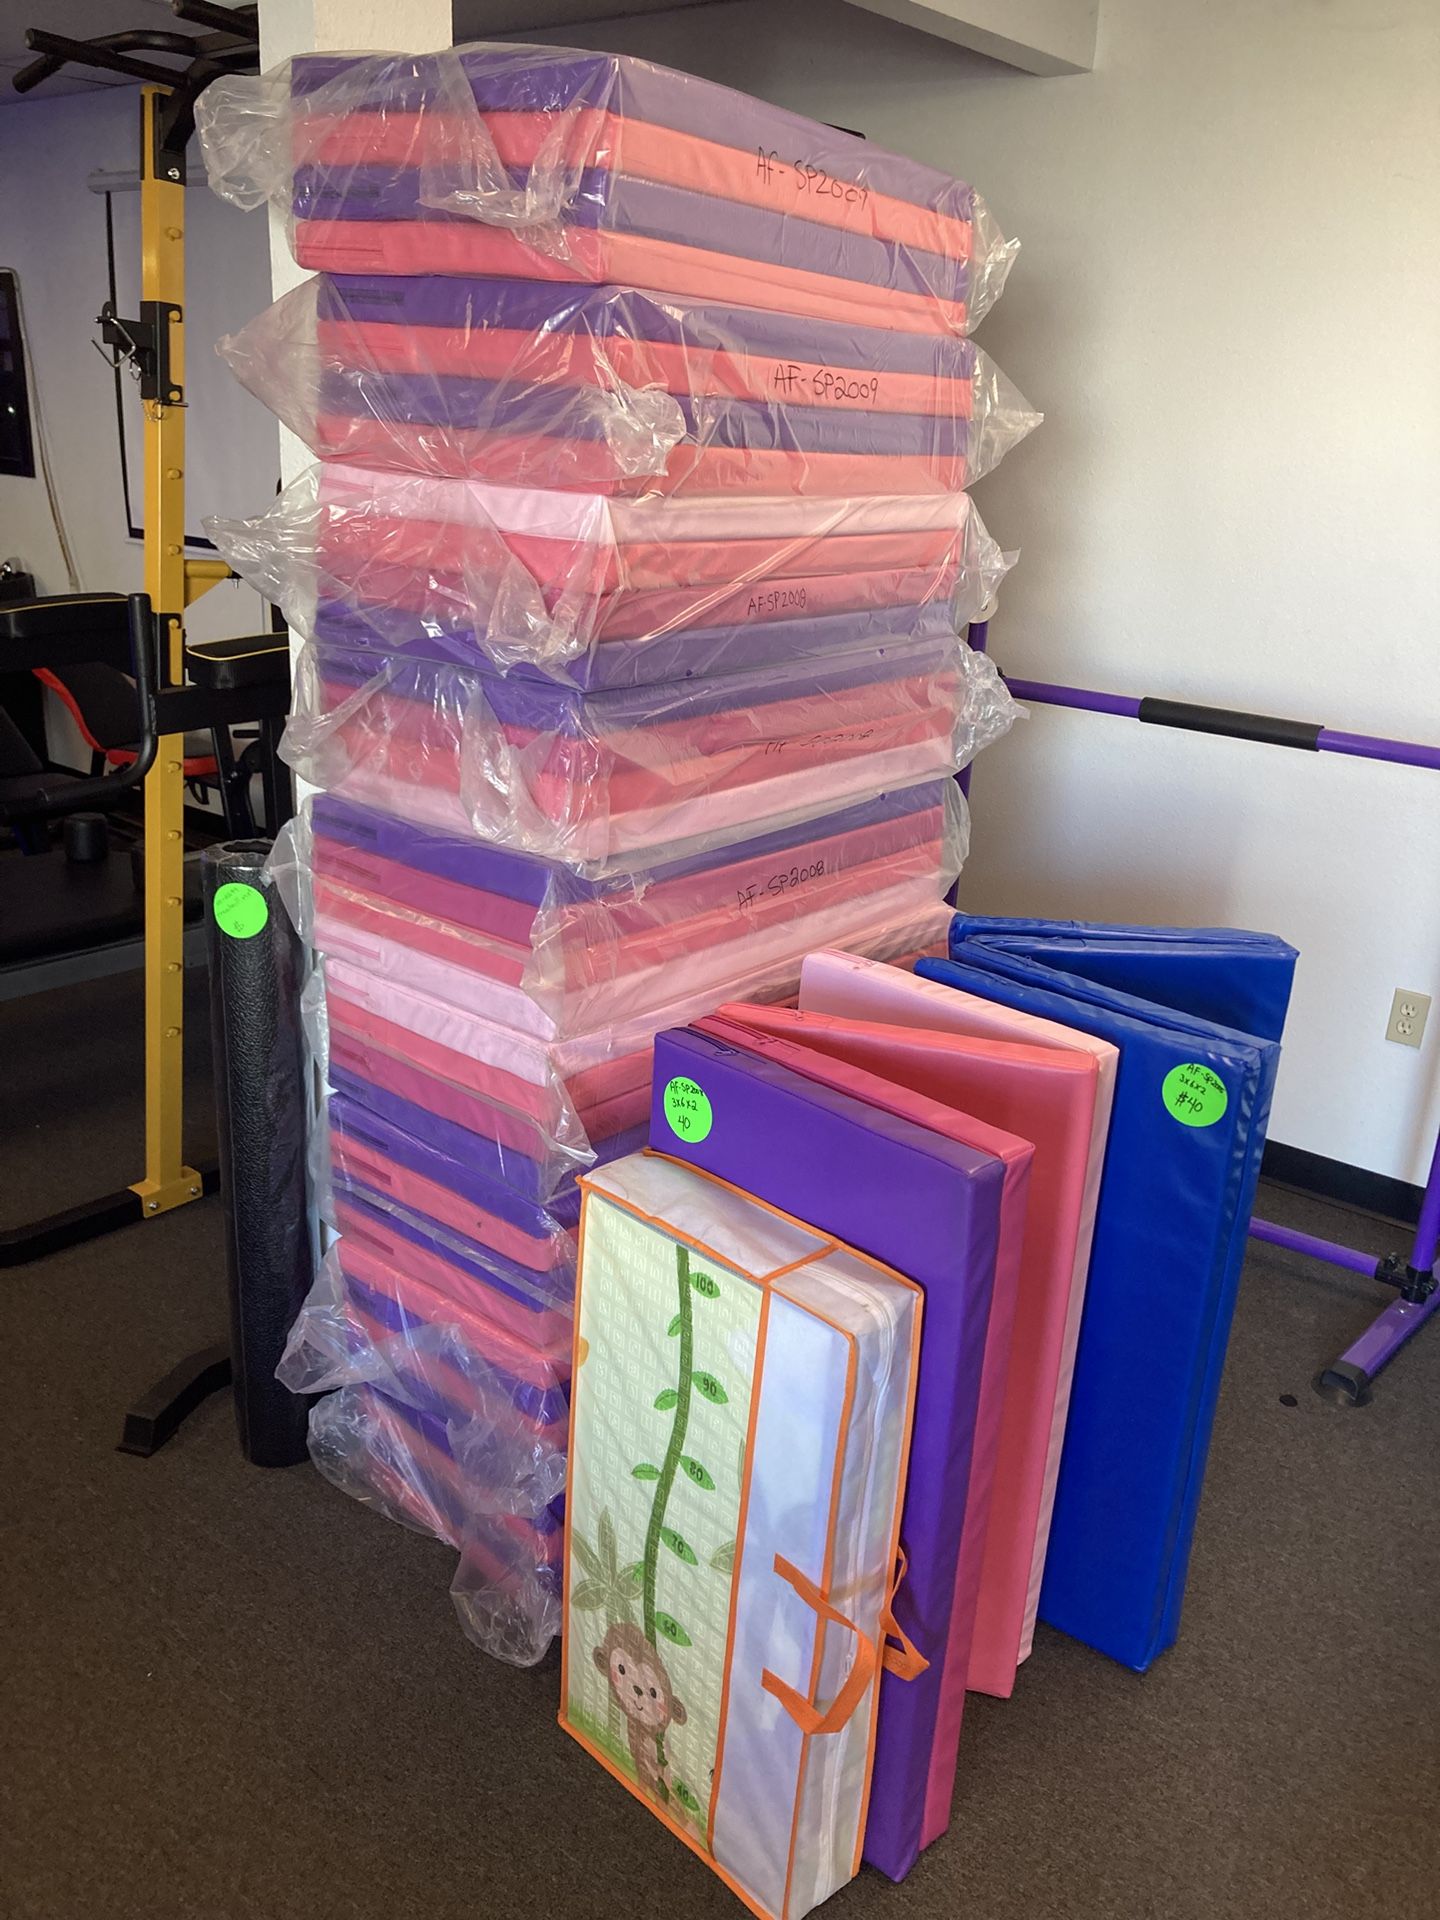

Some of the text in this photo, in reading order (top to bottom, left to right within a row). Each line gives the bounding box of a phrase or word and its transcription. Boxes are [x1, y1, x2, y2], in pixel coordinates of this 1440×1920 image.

[774, 363, 878, 405] AF-SP2009
[677, 1115, 691, 1132] 40
[696, 1275, 714, 1296] 100
[702, 1377, 717, 1397] 90
[689, 1461, 703, 1482] 80
[672, 1535, 683, 1553] 70
